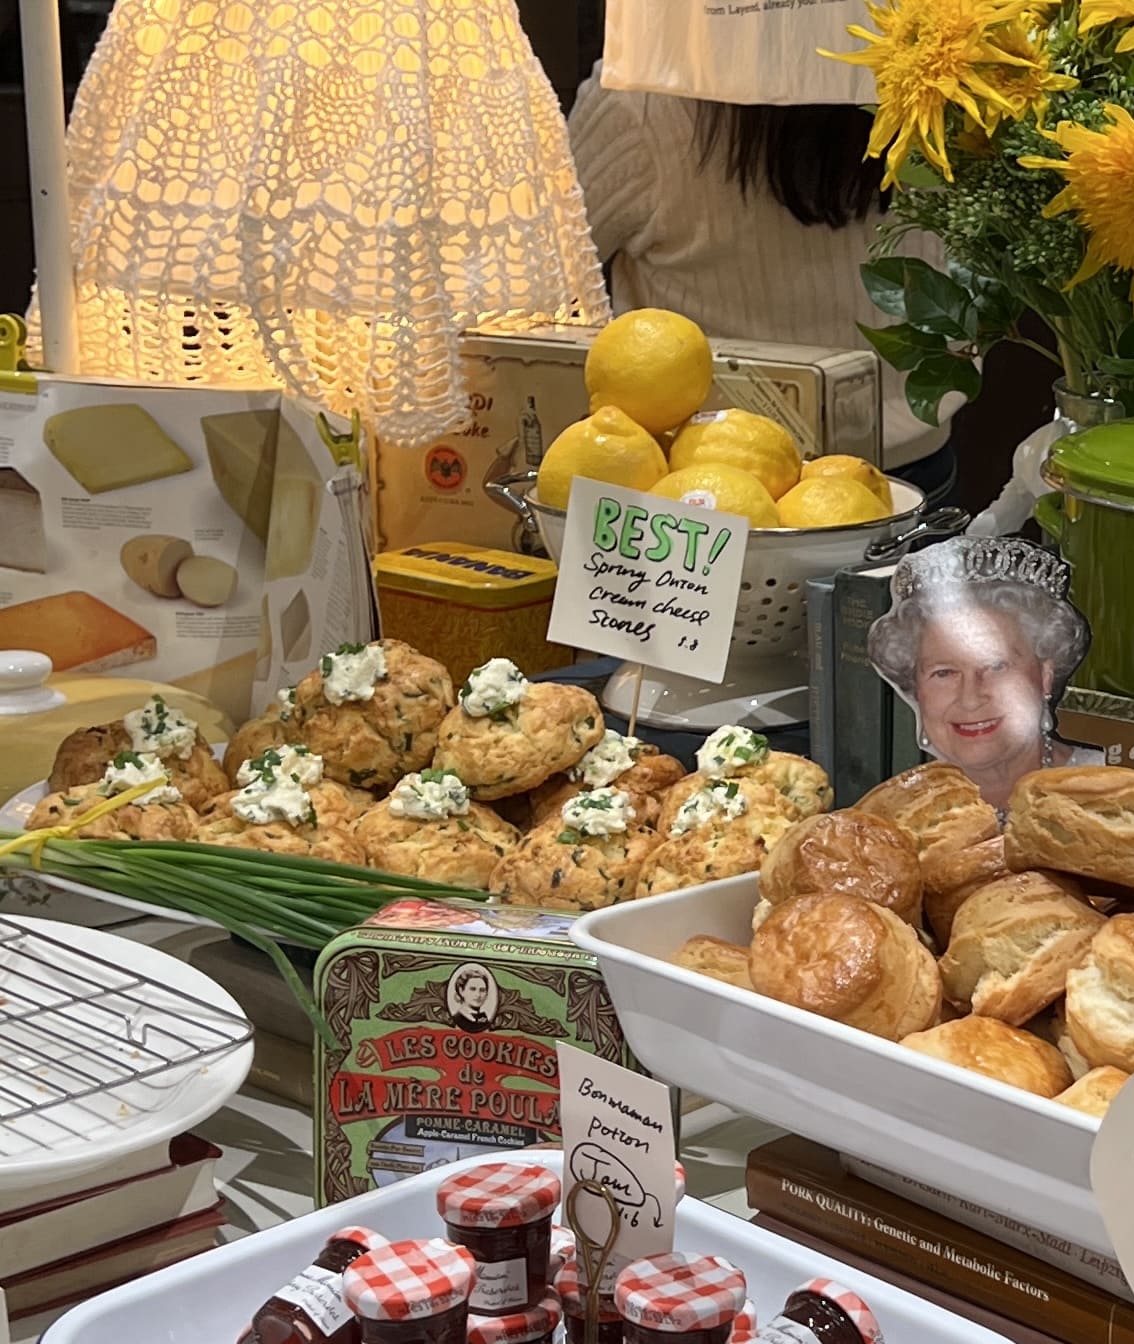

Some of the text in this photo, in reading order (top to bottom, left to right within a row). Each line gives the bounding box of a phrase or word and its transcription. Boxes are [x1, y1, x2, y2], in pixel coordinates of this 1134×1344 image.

[593, 497, 732, 576] BEST!
[655, 570, 709, 595] Onion
[589, 609, 657, 642] Scones
[653, 597, 710, 626] cheese
[385, 1035, 558, 1077] LES COOKIES
[458, 1063, 486, 1085] de
[338, 1079, 375, 1114] LA
[383, 1076, 463, 1110] MÈRE
[416, 1116, 526, 1137] POMME-CARAMEL
[416, 1127, 525, 1147] Apple-Caramel French Cookies
[781, 1178, 1050, 1302] PORK QUALITY: Genetic and Metabolic Factors
